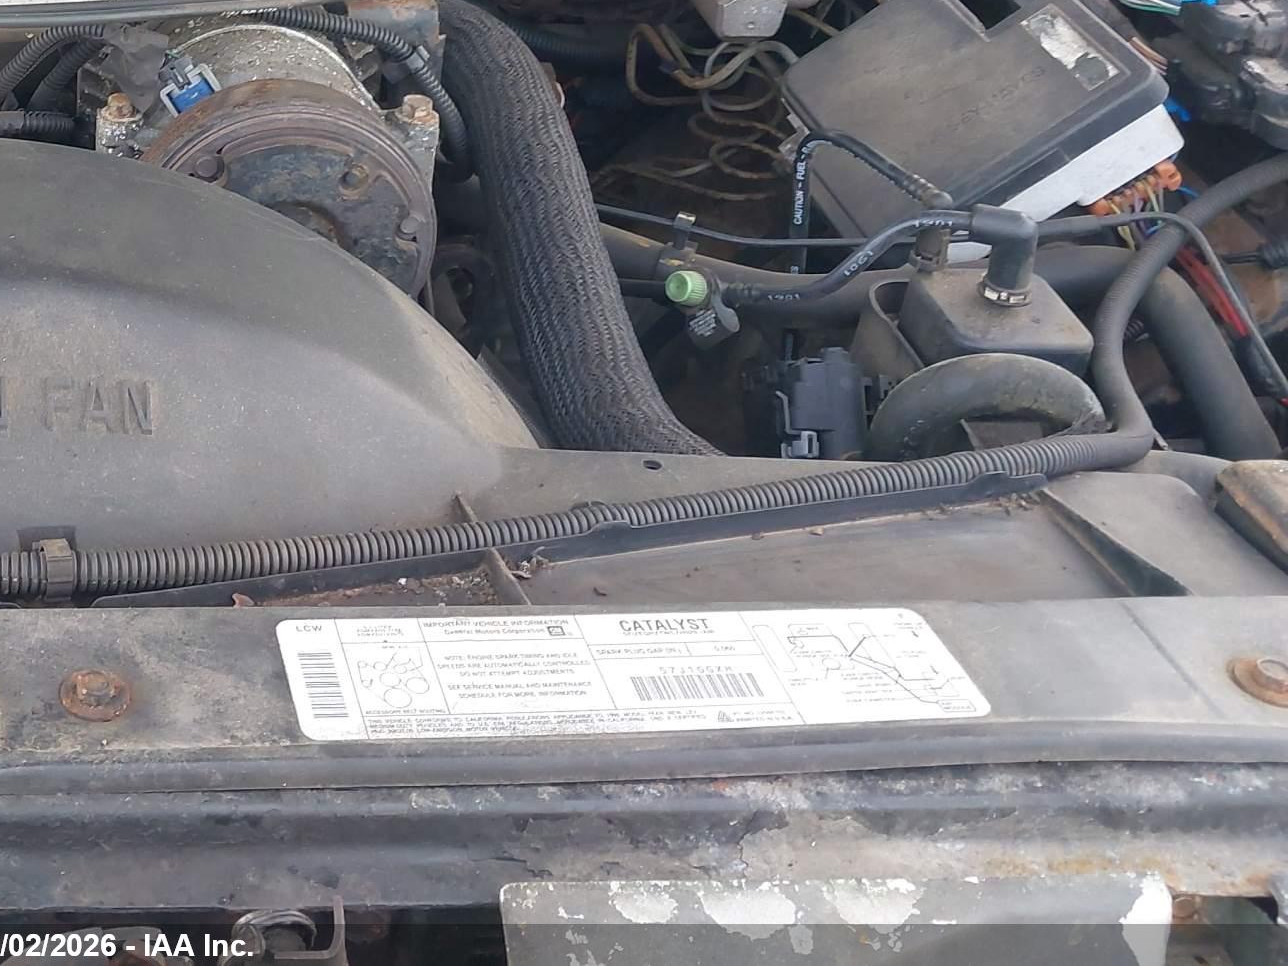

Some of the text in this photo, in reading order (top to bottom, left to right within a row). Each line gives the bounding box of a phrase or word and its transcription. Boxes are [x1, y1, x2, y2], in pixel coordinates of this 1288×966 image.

[795, 160, 807, 181] FUEL
[793, 190, 806, 225] CAUTION
[43, 377, 154, 435] FAN
[295, 625, 323, 633] LCW
[423, 618, 569, 629] IMPORTANT VEHICLE INFORMATION
[619, 618, 710, 633] CATALYST
[444, 628, 473, 636] General
[502, 627, 546, 635] Corporation
[485, 661, 541, 669] AUTOMATICALLY
